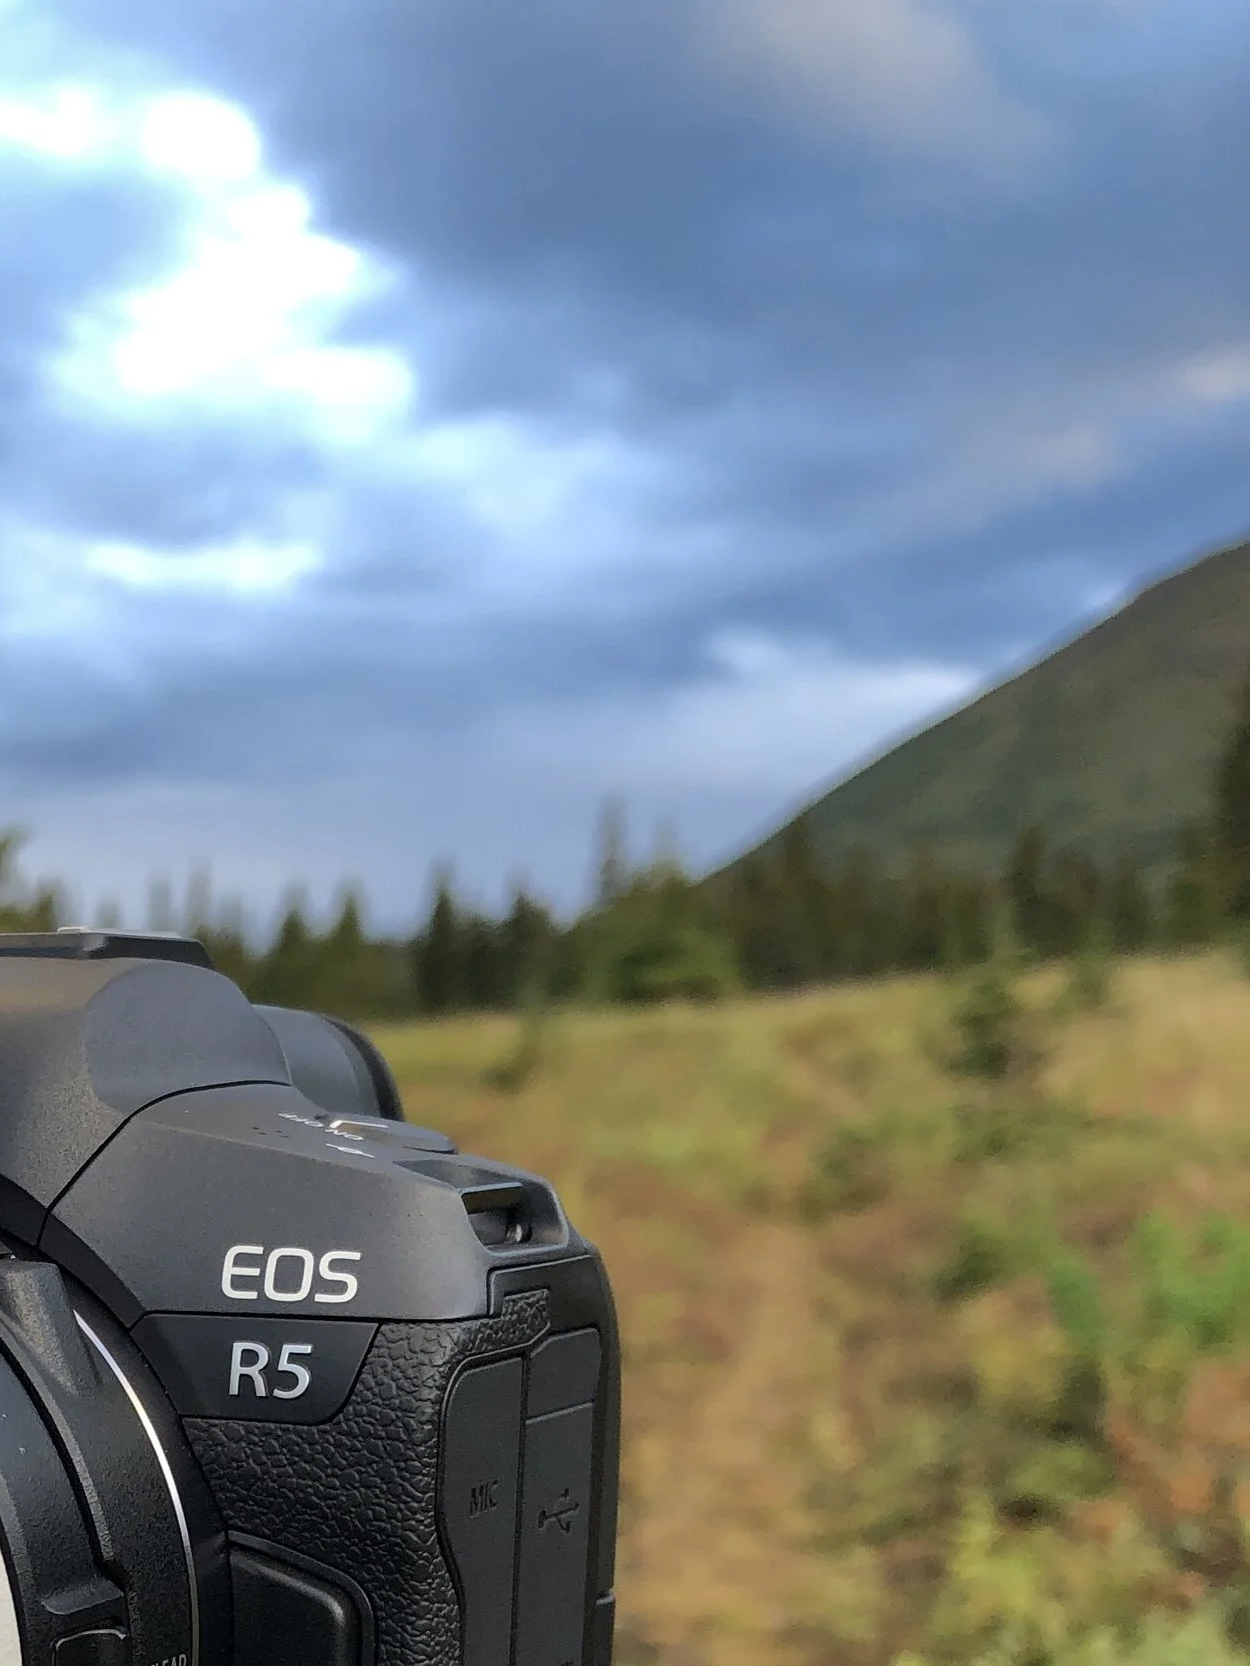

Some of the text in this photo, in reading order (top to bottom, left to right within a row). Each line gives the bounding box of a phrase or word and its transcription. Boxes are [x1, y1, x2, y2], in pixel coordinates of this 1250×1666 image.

[324, 1128, 363, 1140] ON
[221, 1245, 361, 1303] EOS
[228, 1342, 312, 1399] R5
[469, 1480, 500, 1517] MIC
